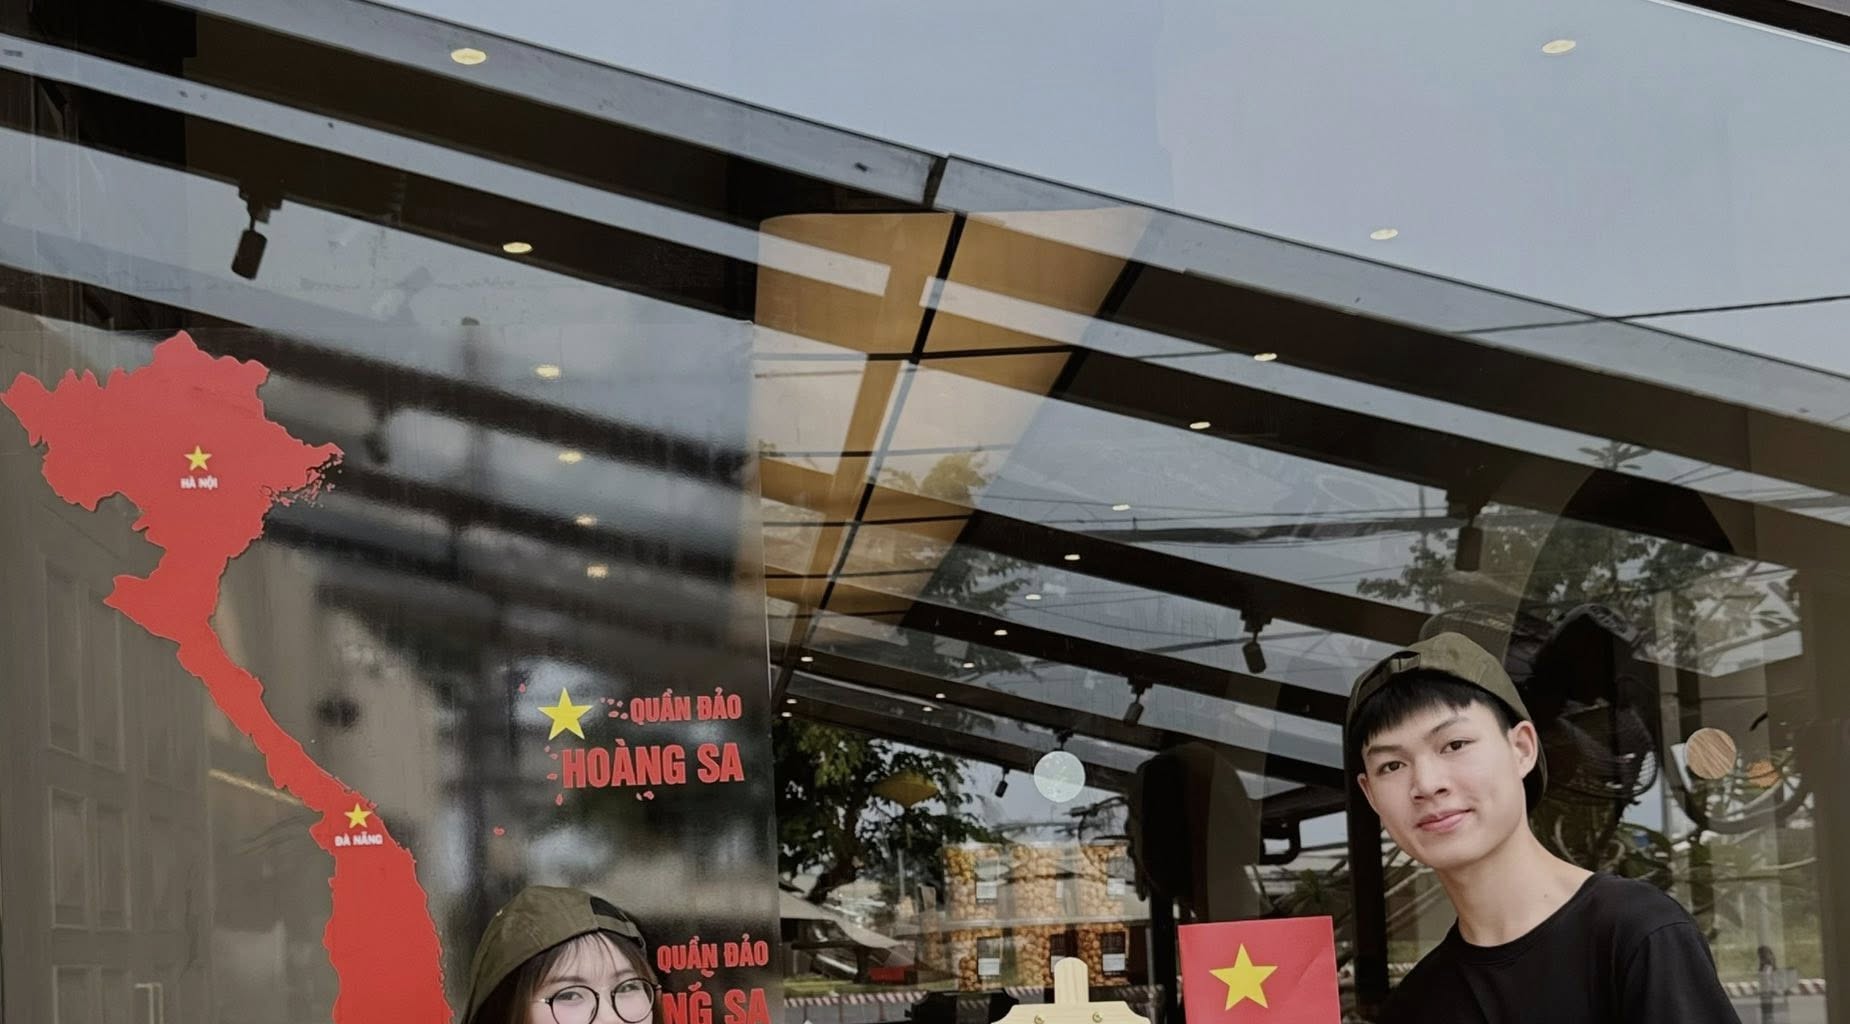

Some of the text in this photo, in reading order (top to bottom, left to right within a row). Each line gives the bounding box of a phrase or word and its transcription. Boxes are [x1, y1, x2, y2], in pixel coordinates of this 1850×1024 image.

[562, 738, 745, 789] HOÀNG SA
[724, 933, 769, 967] ĐẢO
